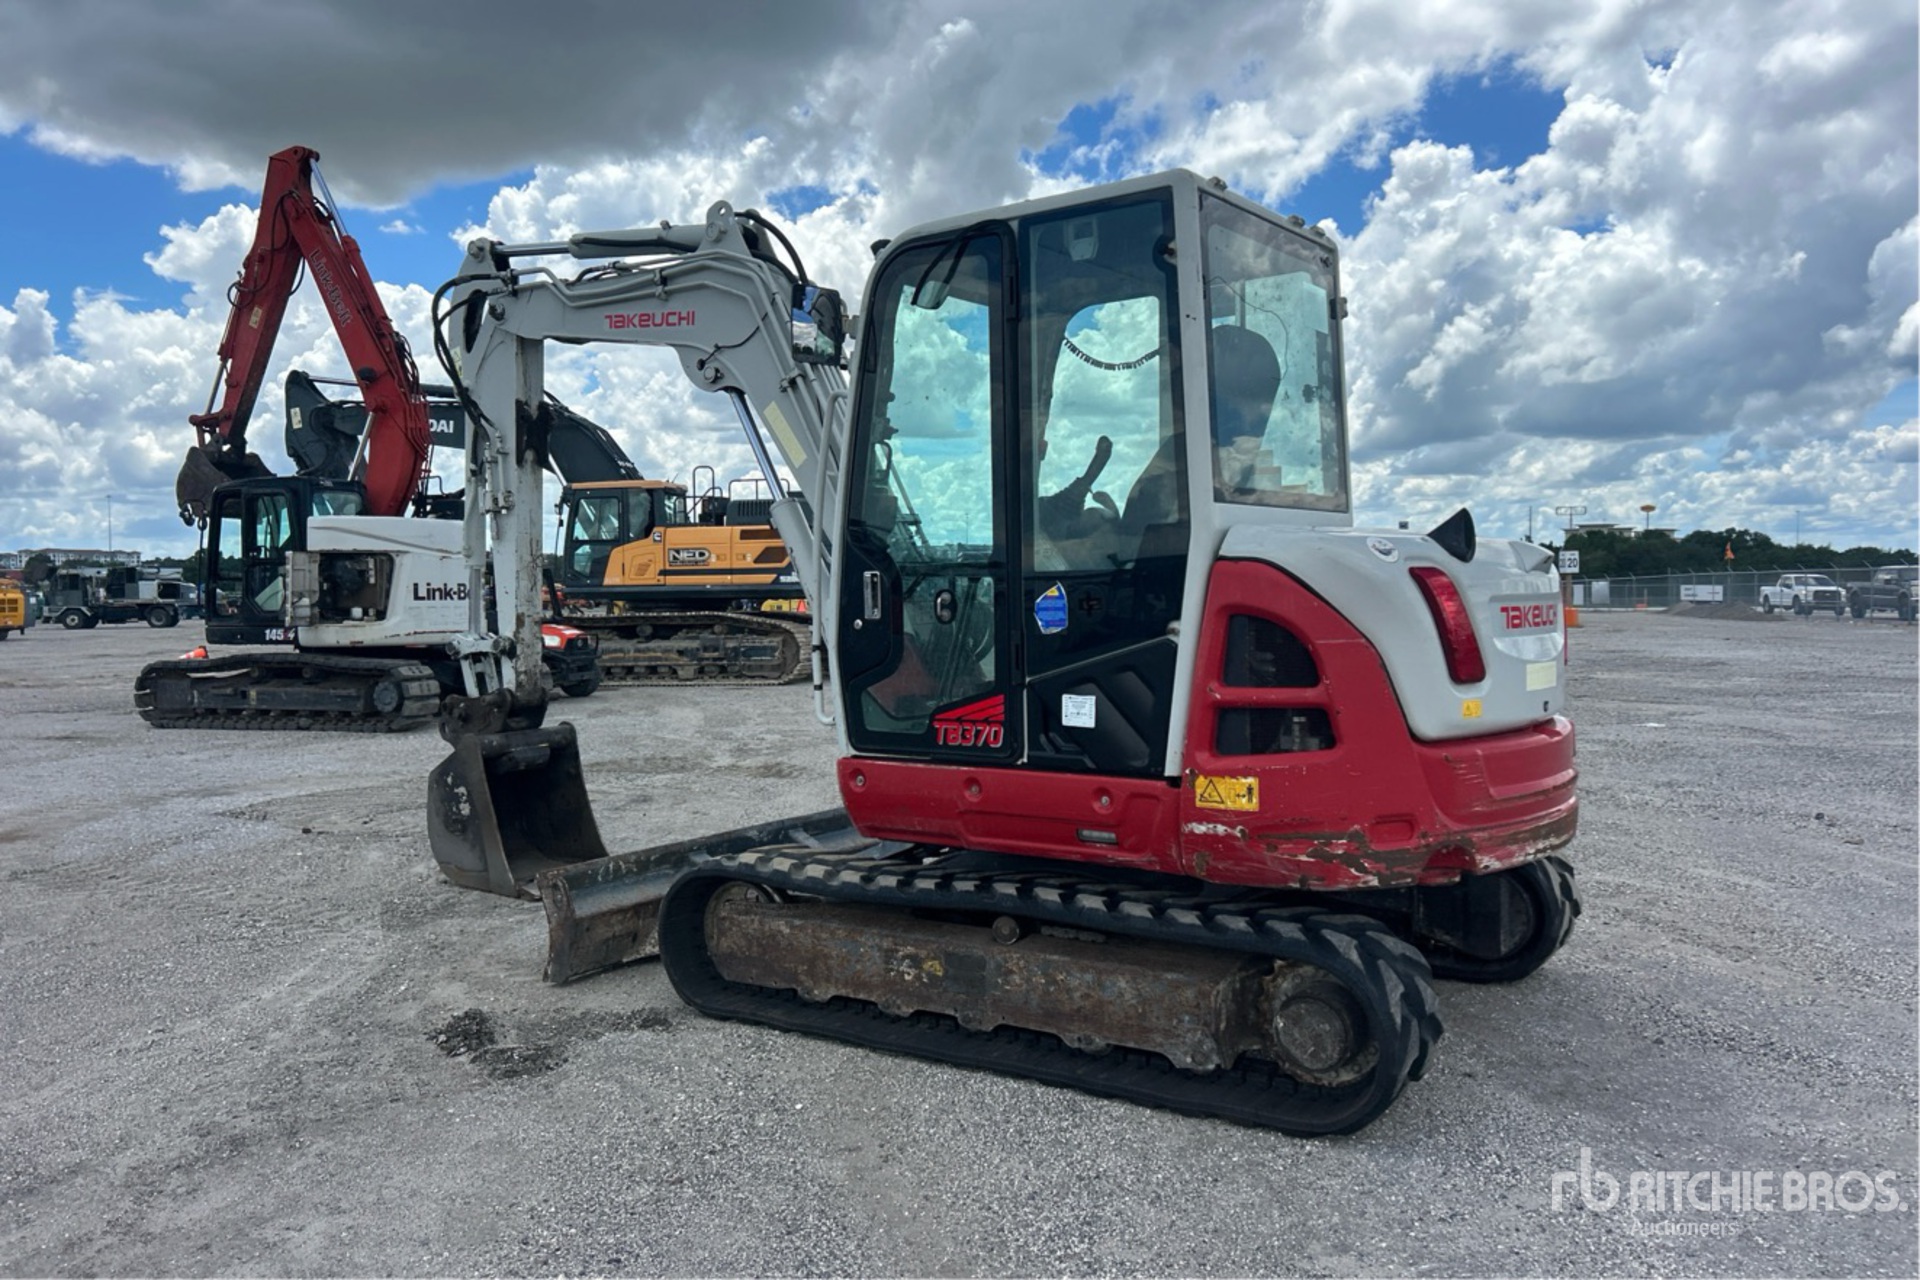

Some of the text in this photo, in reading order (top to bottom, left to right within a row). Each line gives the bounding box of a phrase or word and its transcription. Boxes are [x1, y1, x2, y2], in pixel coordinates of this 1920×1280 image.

[604, 310, 696, 330] TAKEUCHI
[428, 418, 454, 433] DAI
[668, 549, 710, 562] NED
[412, 582, 470, 601] Link-B
[932, 720, 1004, 748] TB370
